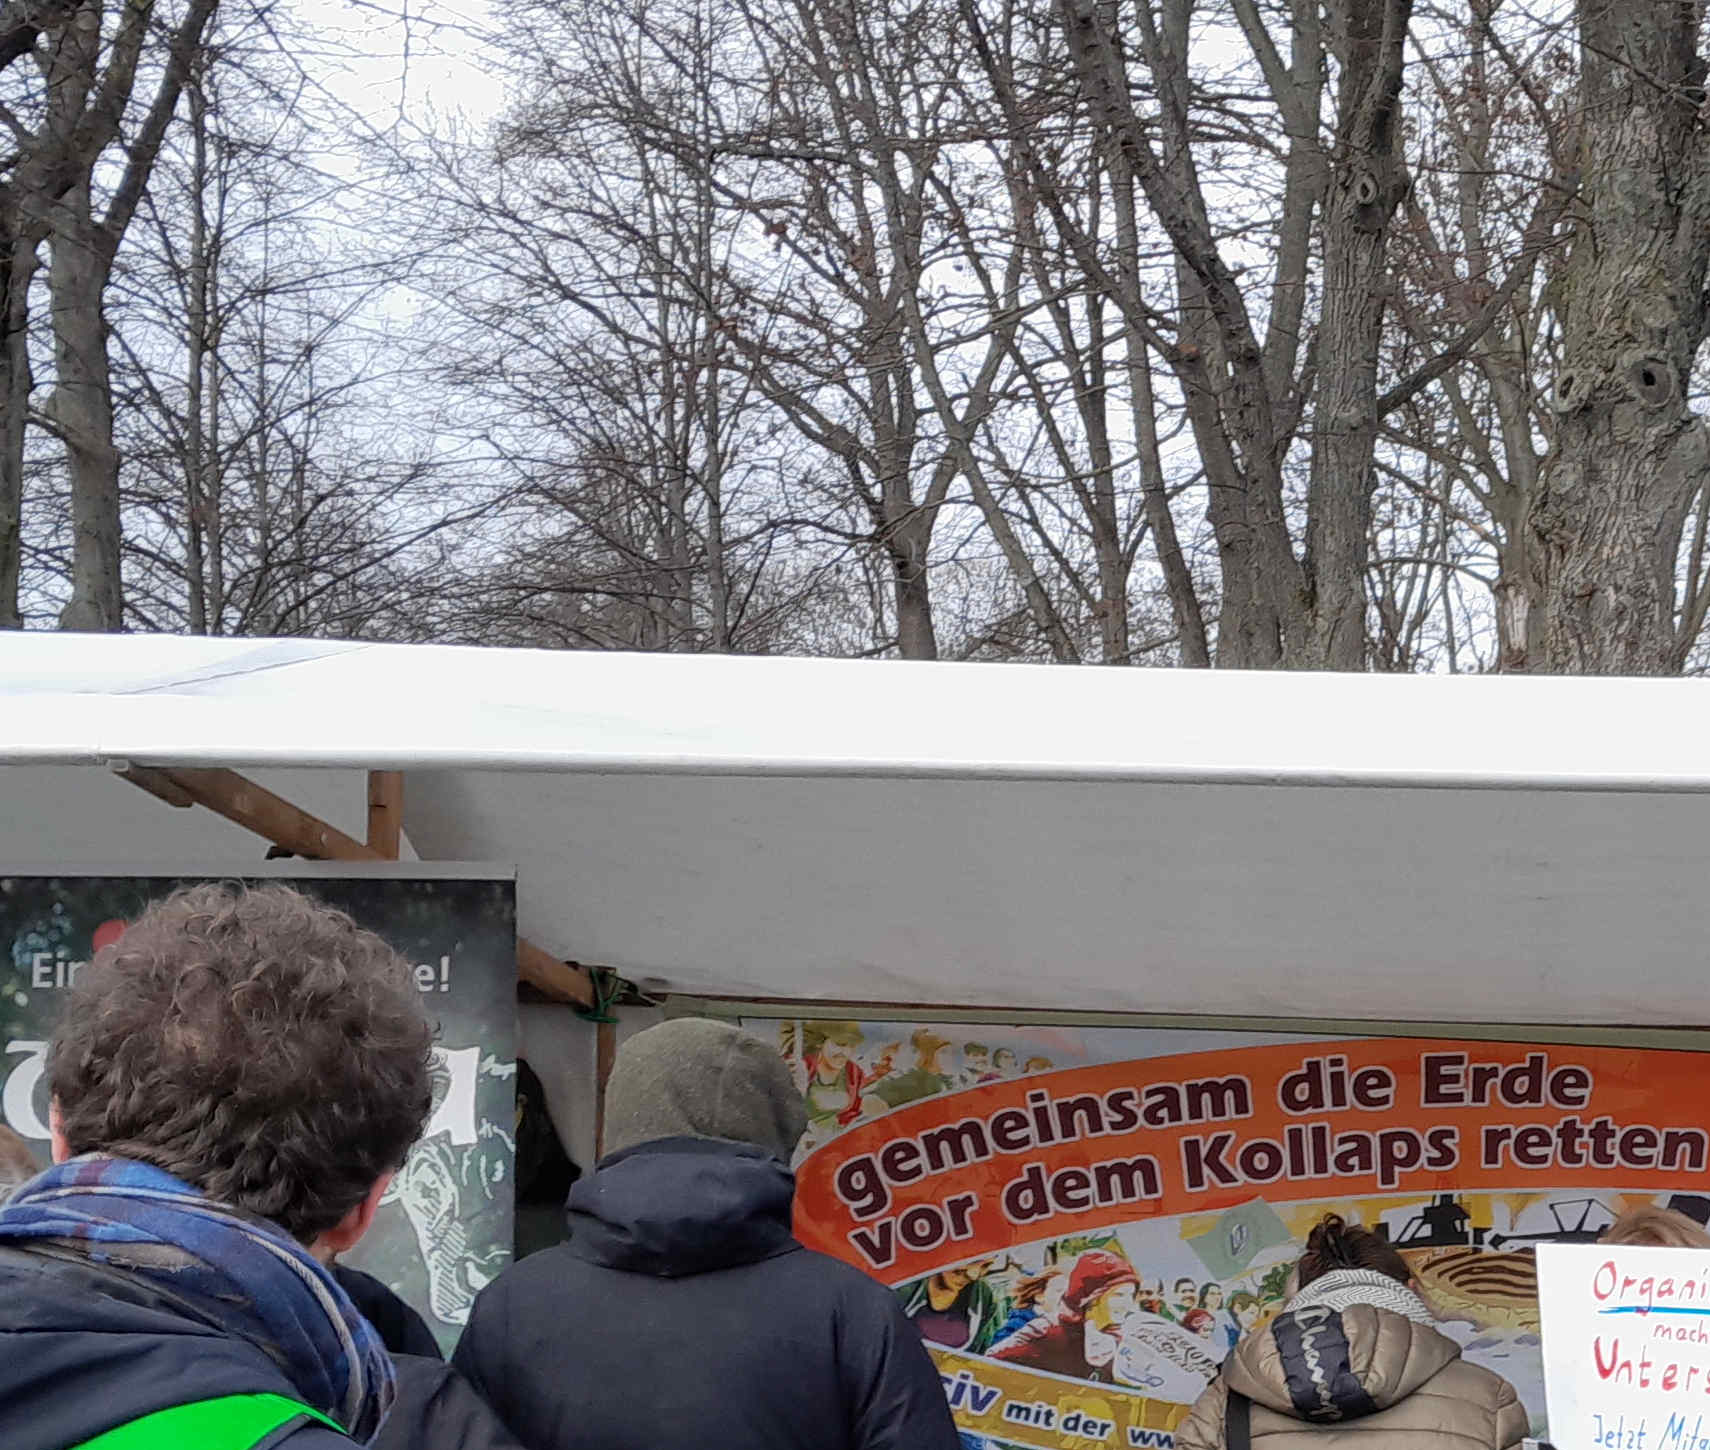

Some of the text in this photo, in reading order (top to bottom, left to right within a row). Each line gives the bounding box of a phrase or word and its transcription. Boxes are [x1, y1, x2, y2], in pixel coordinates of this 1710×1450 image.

[837, 1052, 1592, 1219] gemeinsam die Erde
[853, 1116, 1709, 1269] vor dem Kollaps retten
[1005, 1400, 1056, 1428] mit
[1062, 1411, 1112, 1438] der
[1593, 1414, 1647, 1450] Jetzt
